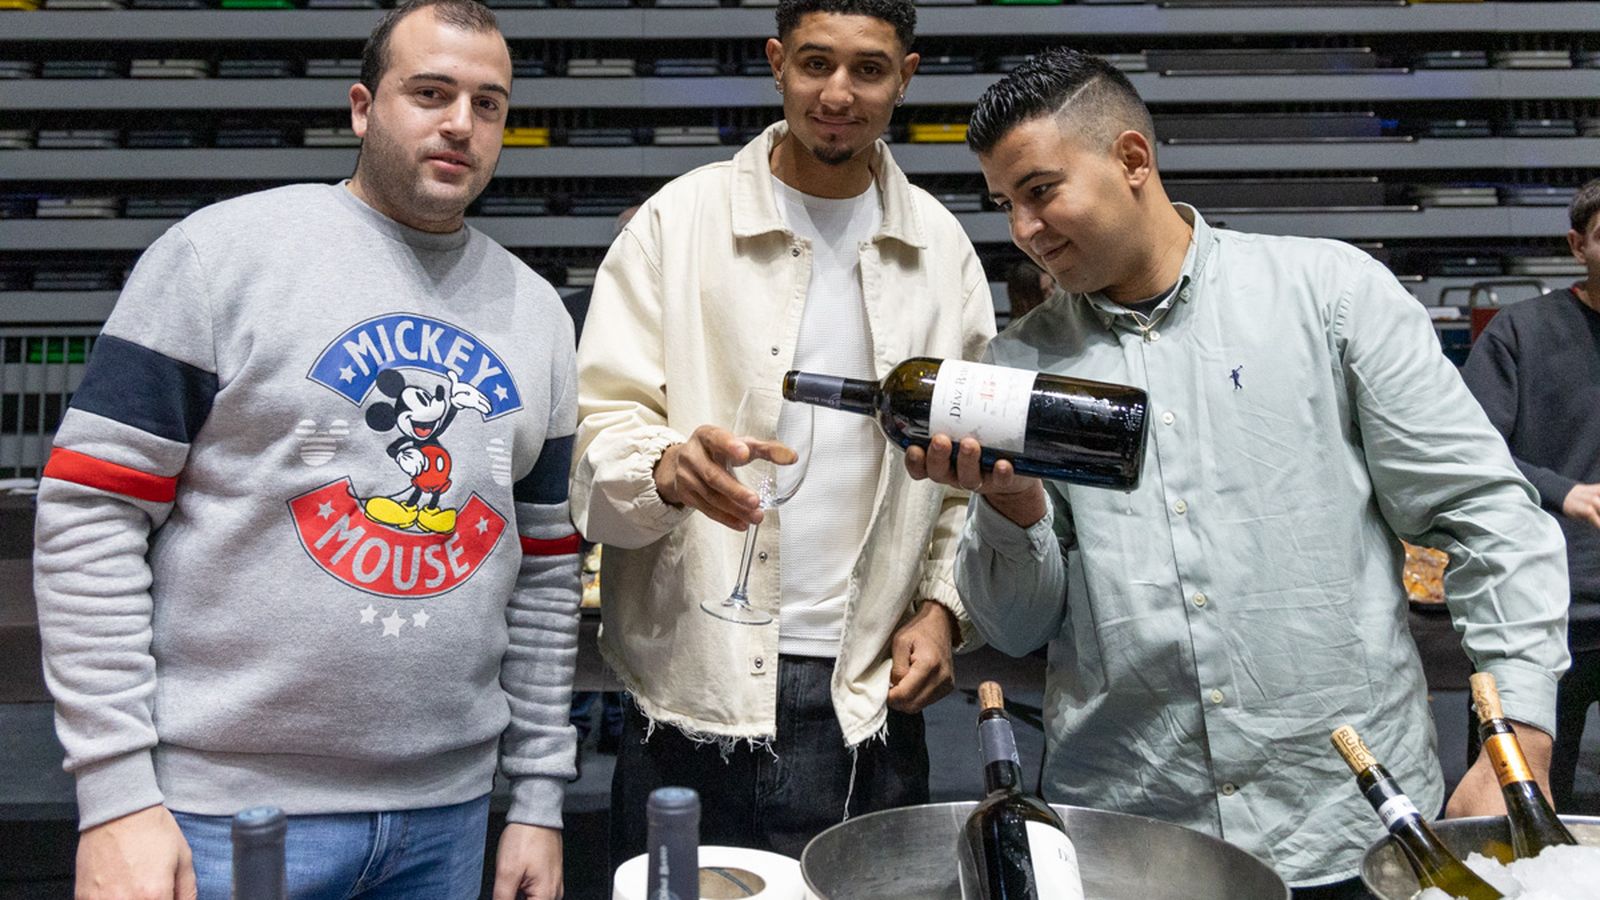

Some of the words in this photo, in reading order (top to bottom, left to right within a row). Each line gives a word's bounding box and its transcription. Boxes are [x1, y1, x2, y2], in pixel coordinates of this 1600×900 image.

[343, 320, 503, 387] MICKEY
[314, 513, 470, 590] MOUSE
[1339, 729, 1371, 769] RUEDA
